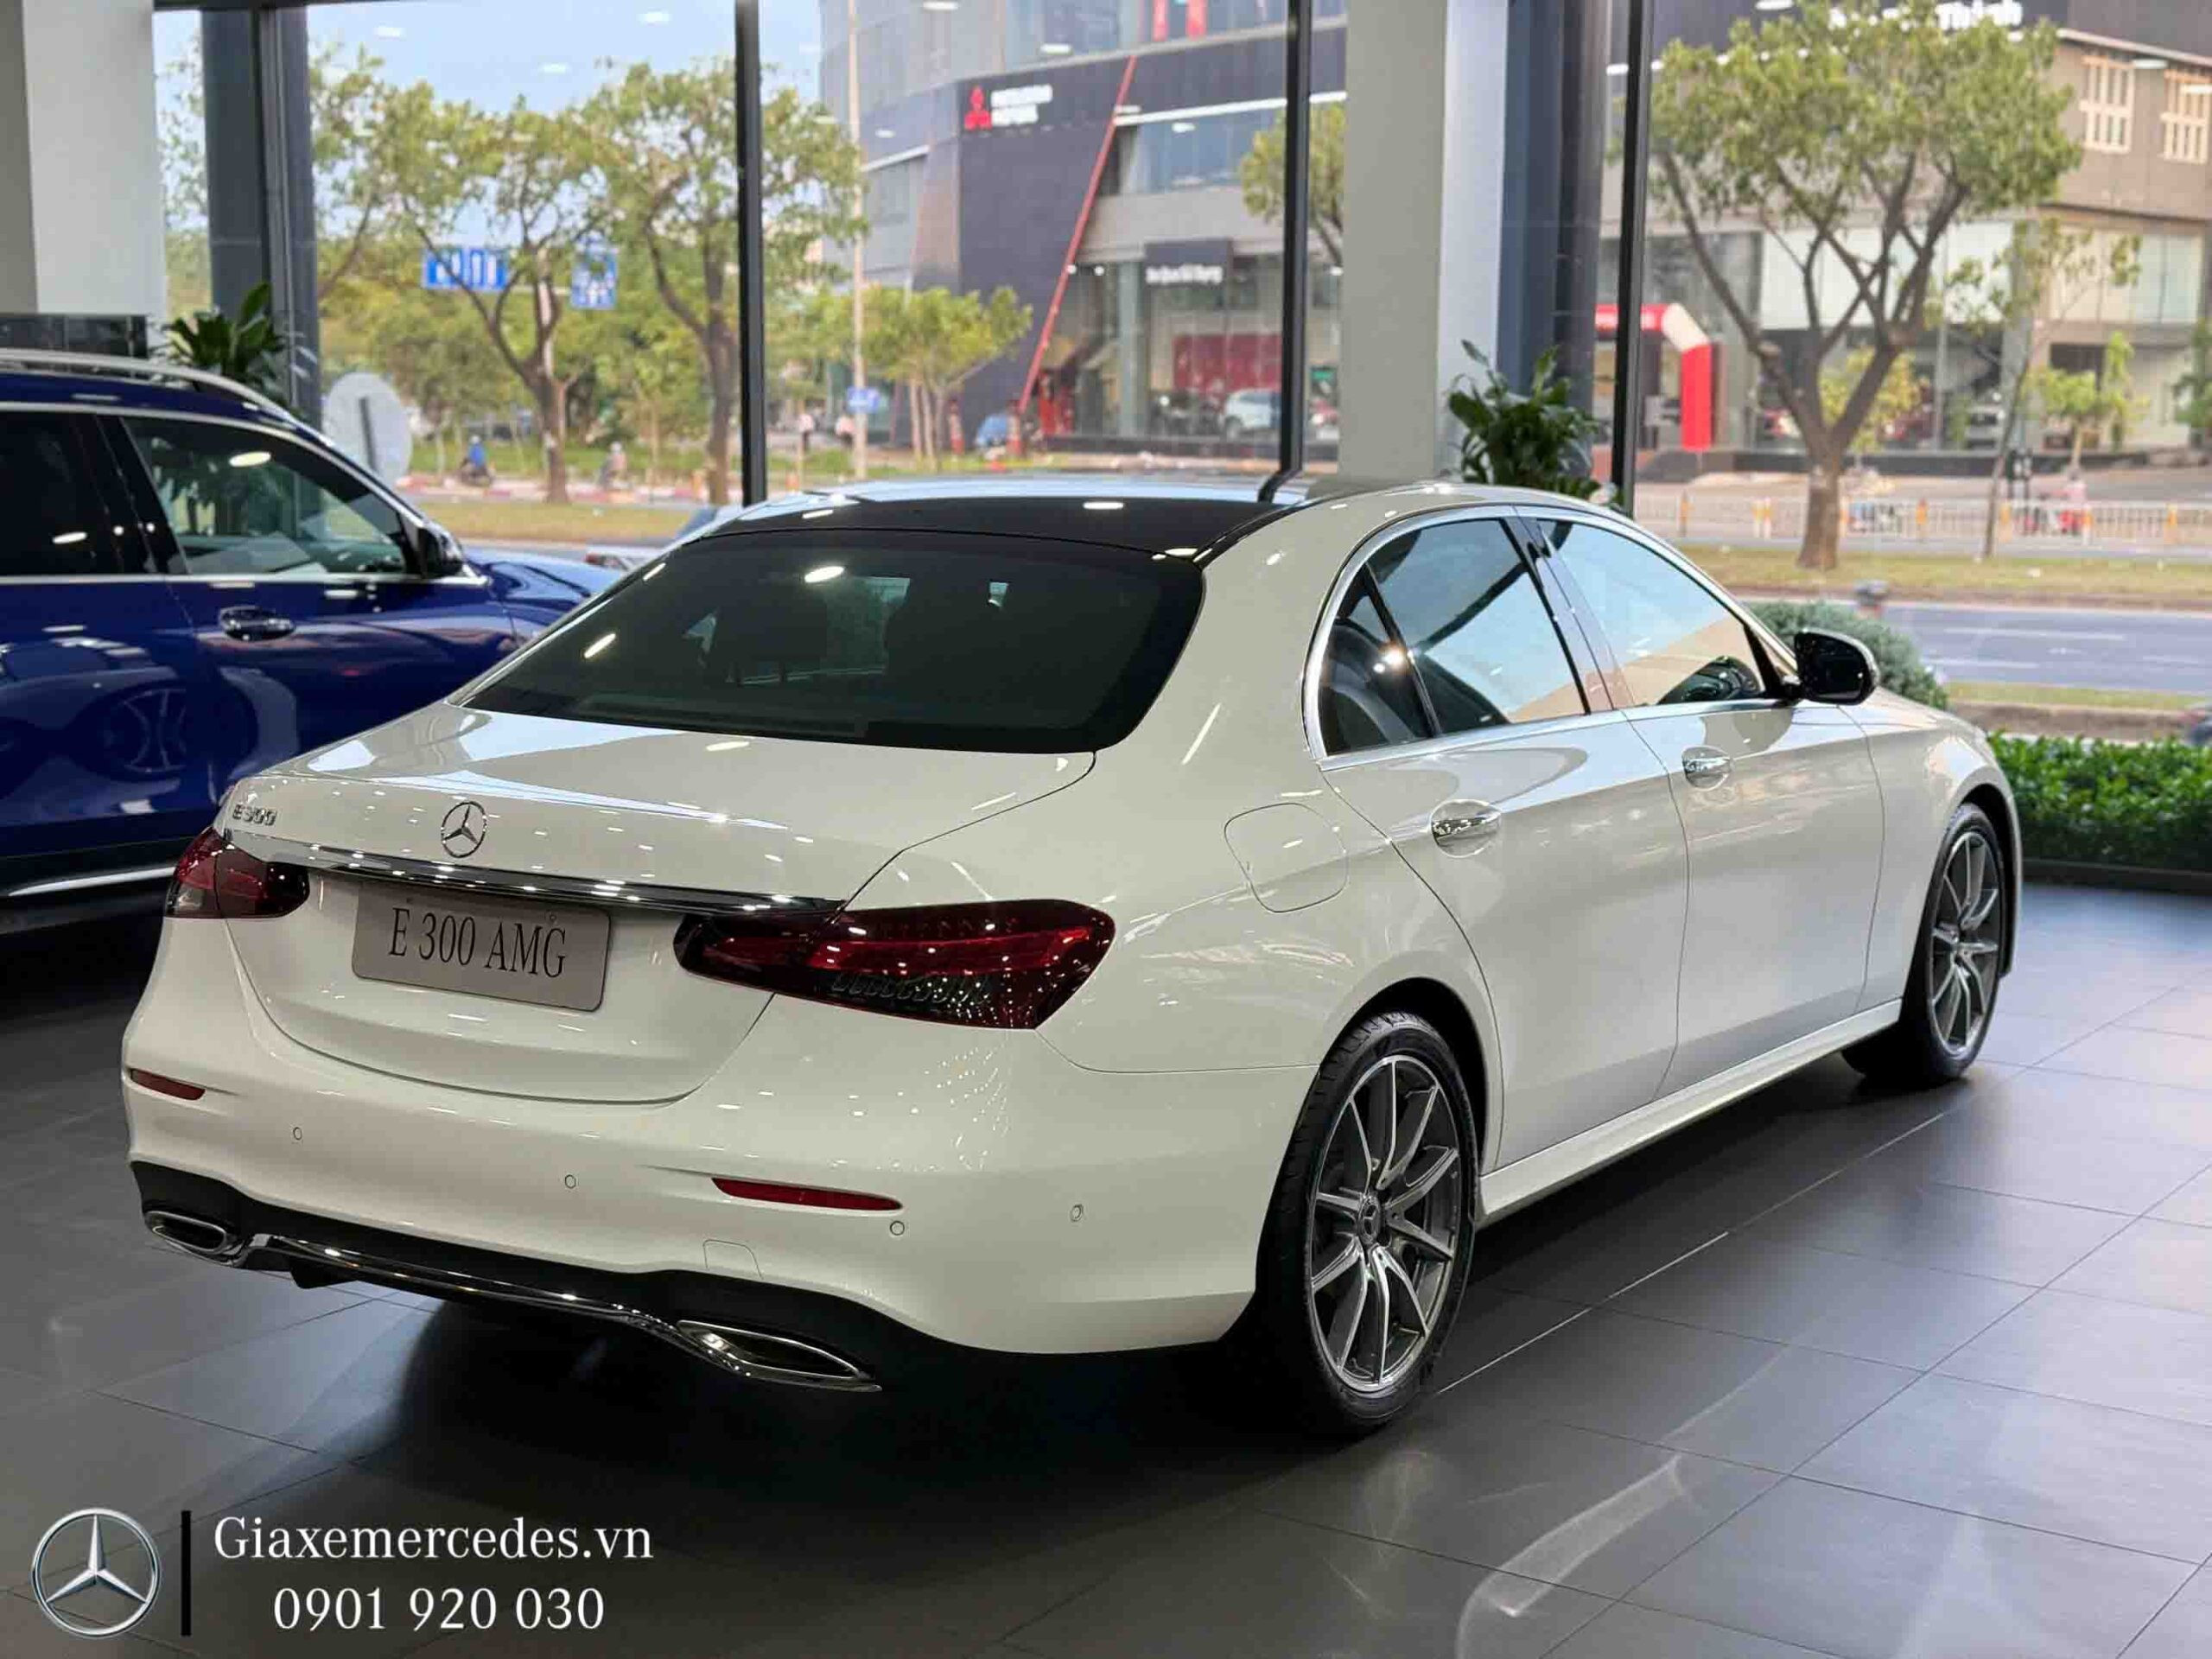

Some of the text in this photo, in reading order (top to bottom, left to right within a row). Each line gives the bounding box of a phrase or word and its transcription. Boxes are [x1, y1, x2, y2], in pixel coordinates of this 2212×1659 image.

[389, 907, 567, 978] E 300 AMG
